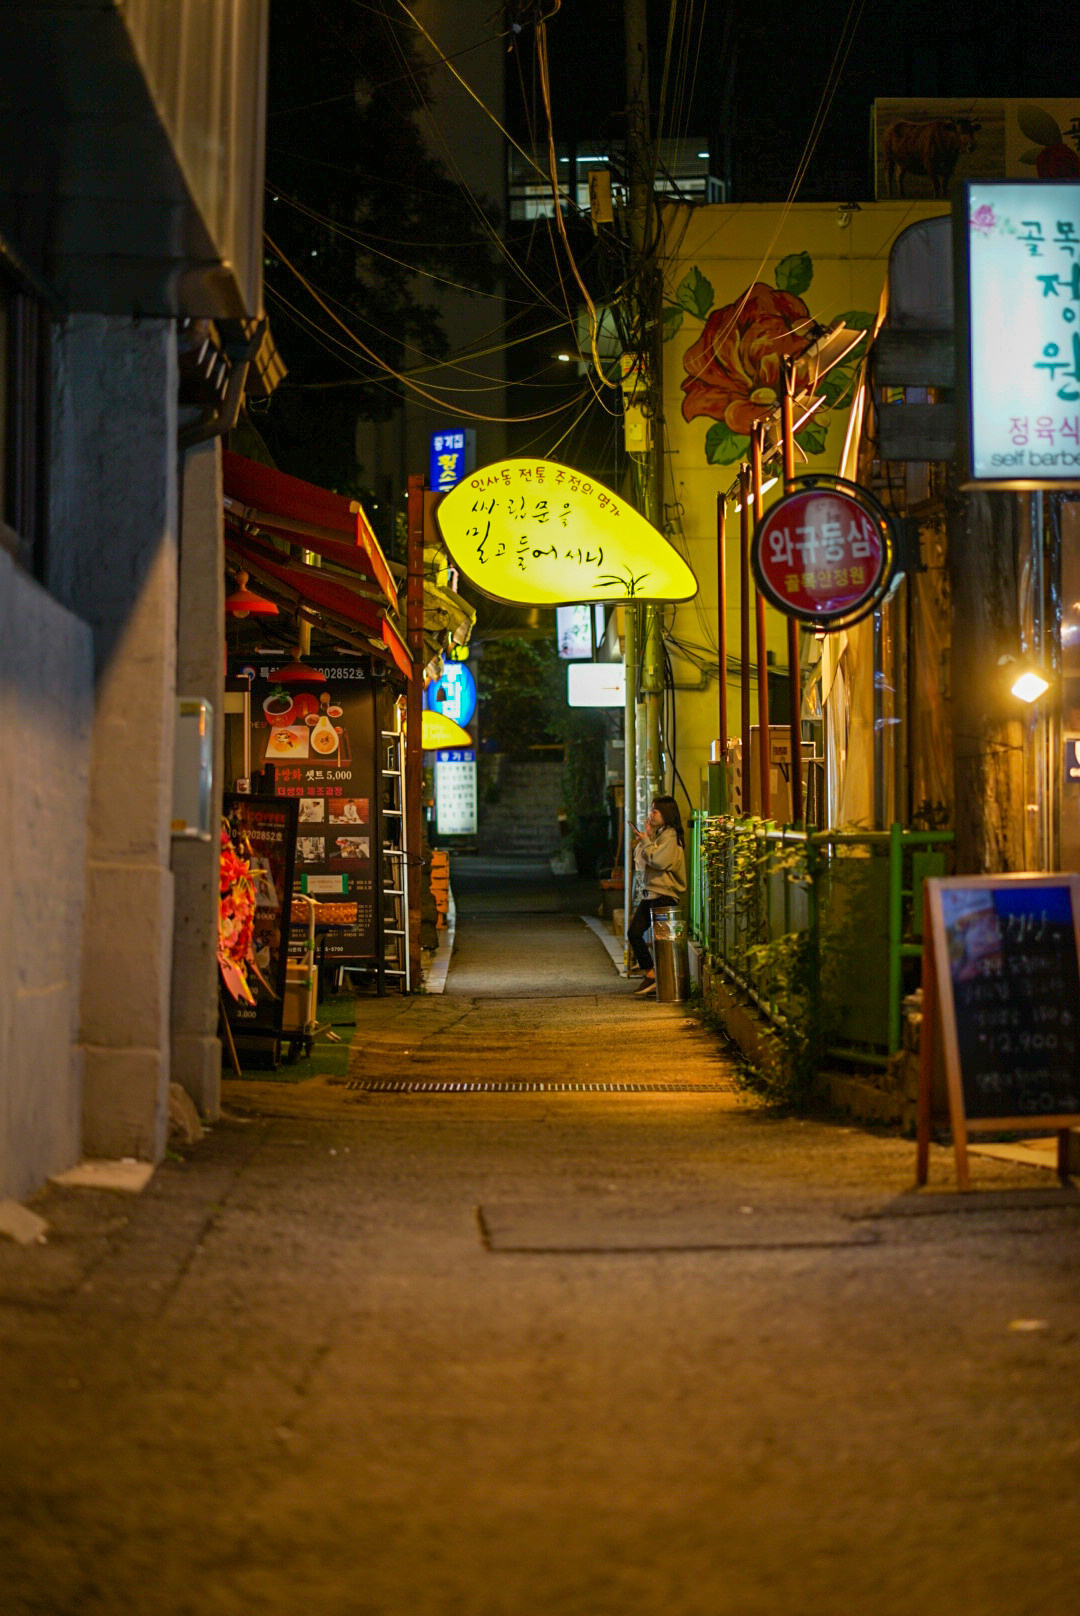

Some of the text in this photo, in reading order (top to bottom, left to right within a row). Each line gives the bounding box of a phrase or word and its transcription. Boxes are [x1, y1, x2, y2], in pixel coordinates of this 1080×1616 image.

[991, 450, 1025, 466] self
[471, 469, 511, 492] 인사동
[518, 466, 546, 484] 전통
[597, 493, 620, 516] 명가
[769, 520, 871, 566] 와규등심
[326, 770, 352, 781] 5,000
